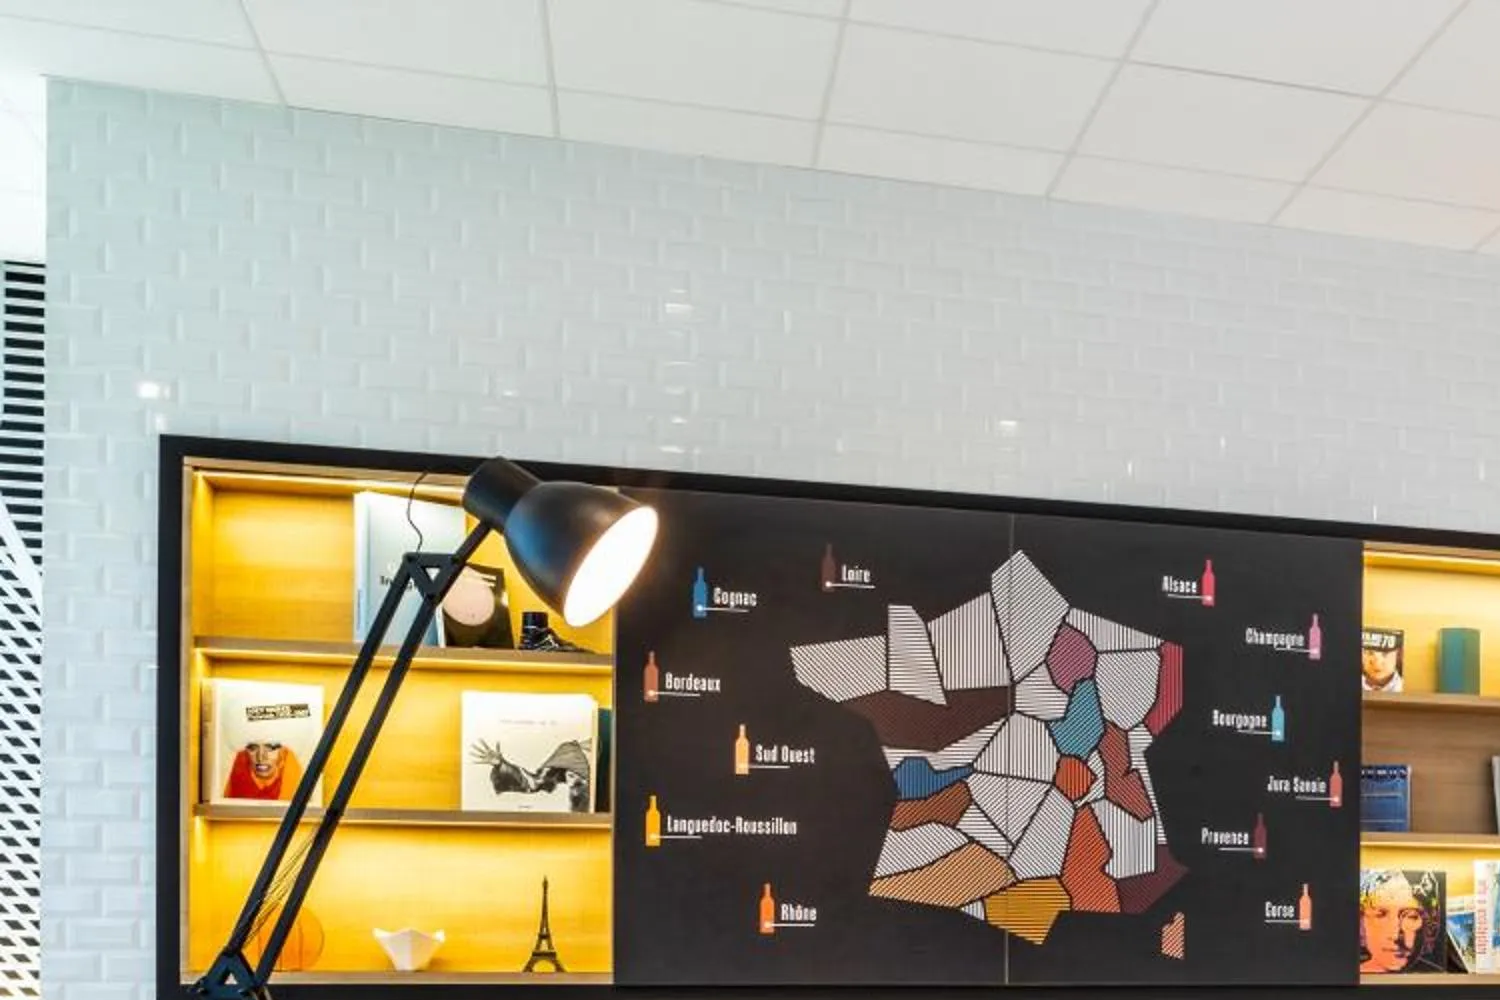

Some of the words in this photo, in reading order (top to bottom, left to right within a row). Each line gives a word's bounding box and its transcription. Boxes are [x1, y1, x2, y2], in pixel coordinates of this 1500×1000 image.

[841, 564, 871, 583] Loire
[1161, 575, 1198, 594] Alsace
[713, 586, 758, 609] Cognac
[1245, 627, 1305, 650] Champagne
[664, 671, 722, 693] Bordeaux
[1212, 709, 1268, 730] Bourgogne
[755, 743, 778, 763] Sud
[781, 744, 816, 764] Ouest
[1267, 775, 1290, 793] Jura
[1293, 776, 1327, 793] Savoie
[666, 814, 798, 836] Languedoc-Roussillon
[1201, 827, 1249, 846] Provence
[780, 903, 817, 921] Rhône
[1264, 901, 1295, 919] Corse
